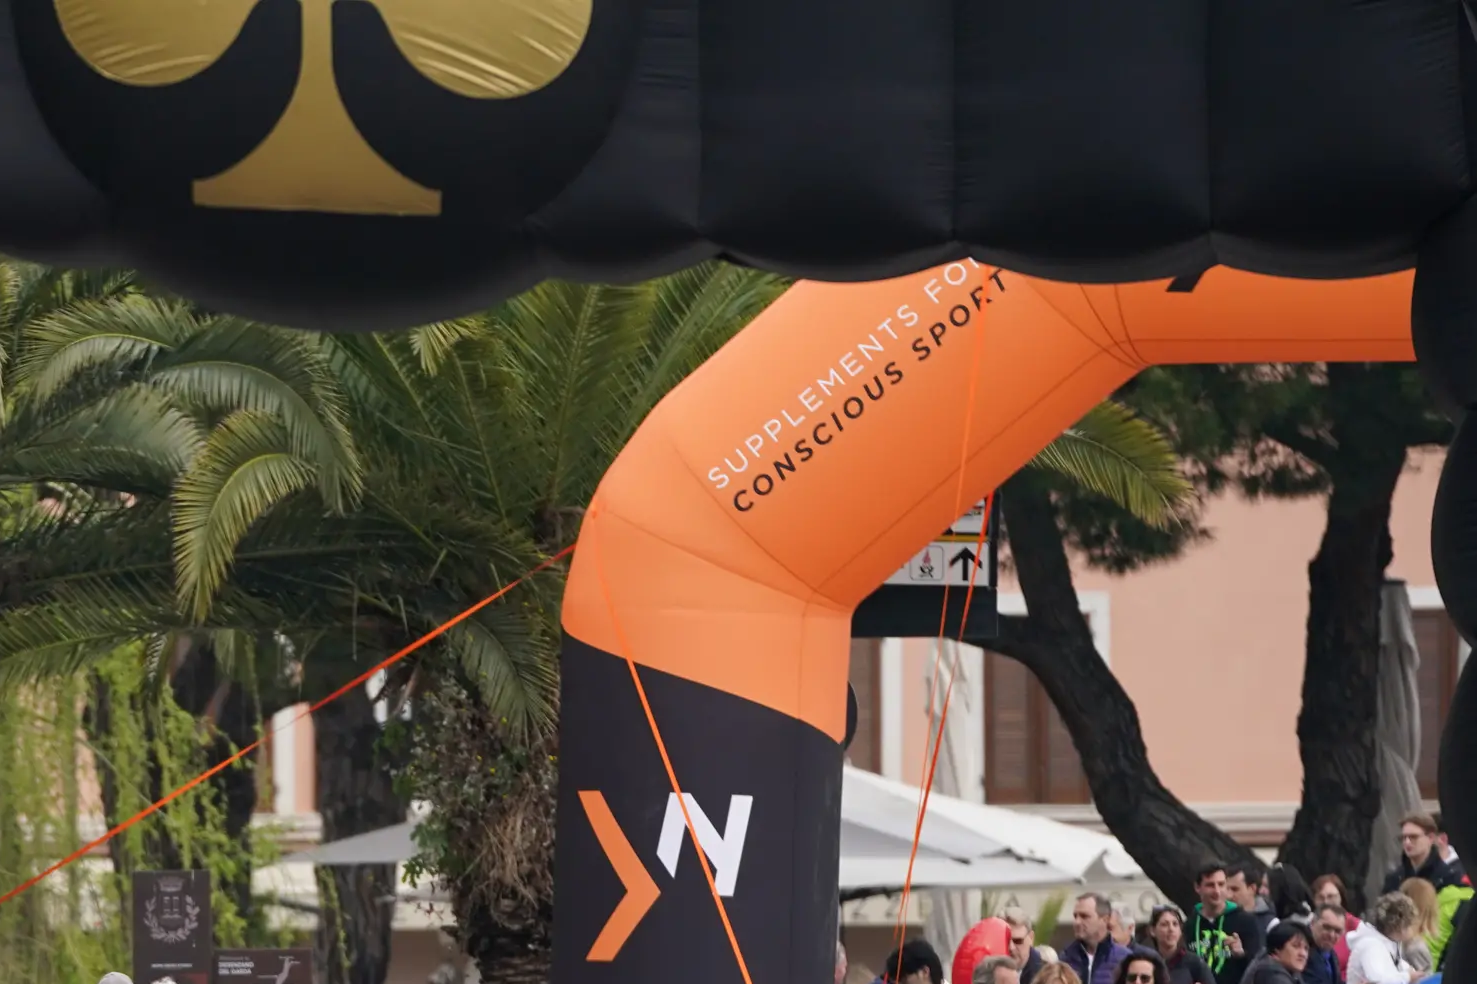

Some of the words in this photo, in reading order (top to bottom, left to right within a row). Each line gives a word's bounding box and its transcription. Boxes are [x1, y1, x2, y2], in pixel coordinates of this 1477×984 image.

[708, 304, 919, 489] SUPPLEMENTS
[733, 361, 904, 512] CONSCIOUS
[912, 268, 1010, 361] SPORT
